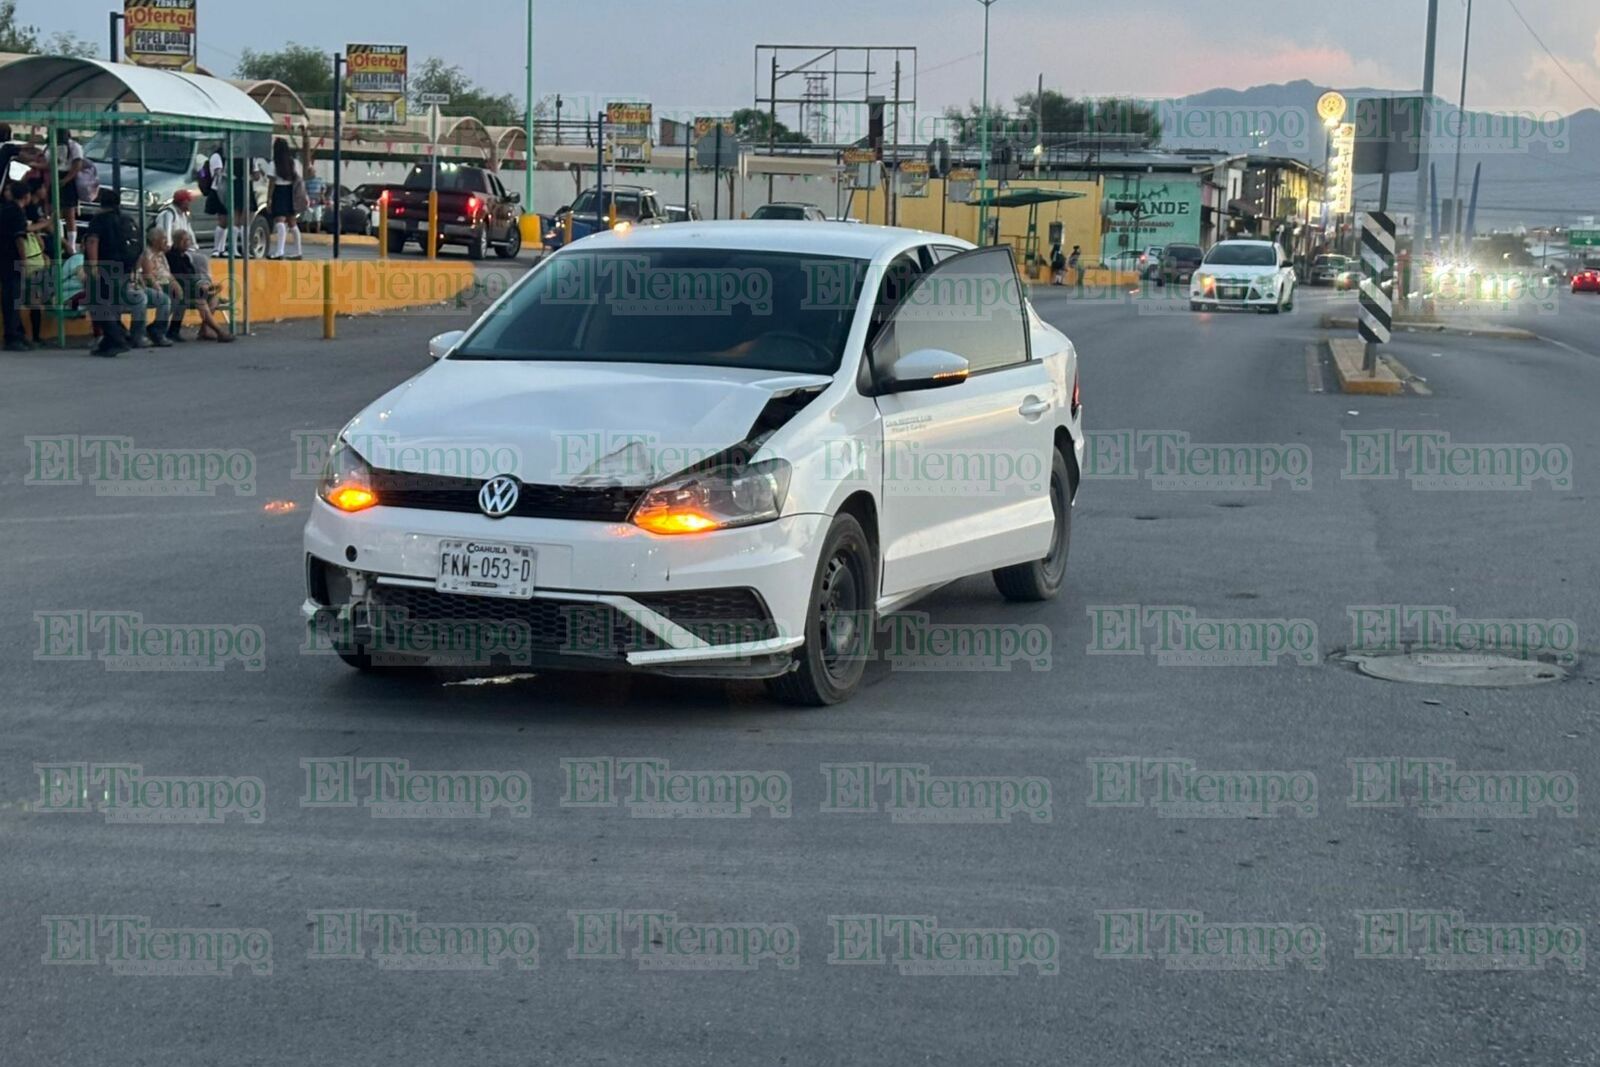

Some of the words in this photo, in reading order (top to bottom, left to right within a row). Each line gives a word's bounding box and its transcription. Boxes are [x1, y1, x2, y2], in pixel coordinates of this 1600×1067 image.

[128, 6, 192, 26] ¡Oferta!
[135, 31, 162, 44] PAPEL
[348, 53, 405, 69] ¡Oferta!
[441, 552, 531, 583] FKW-053-D
